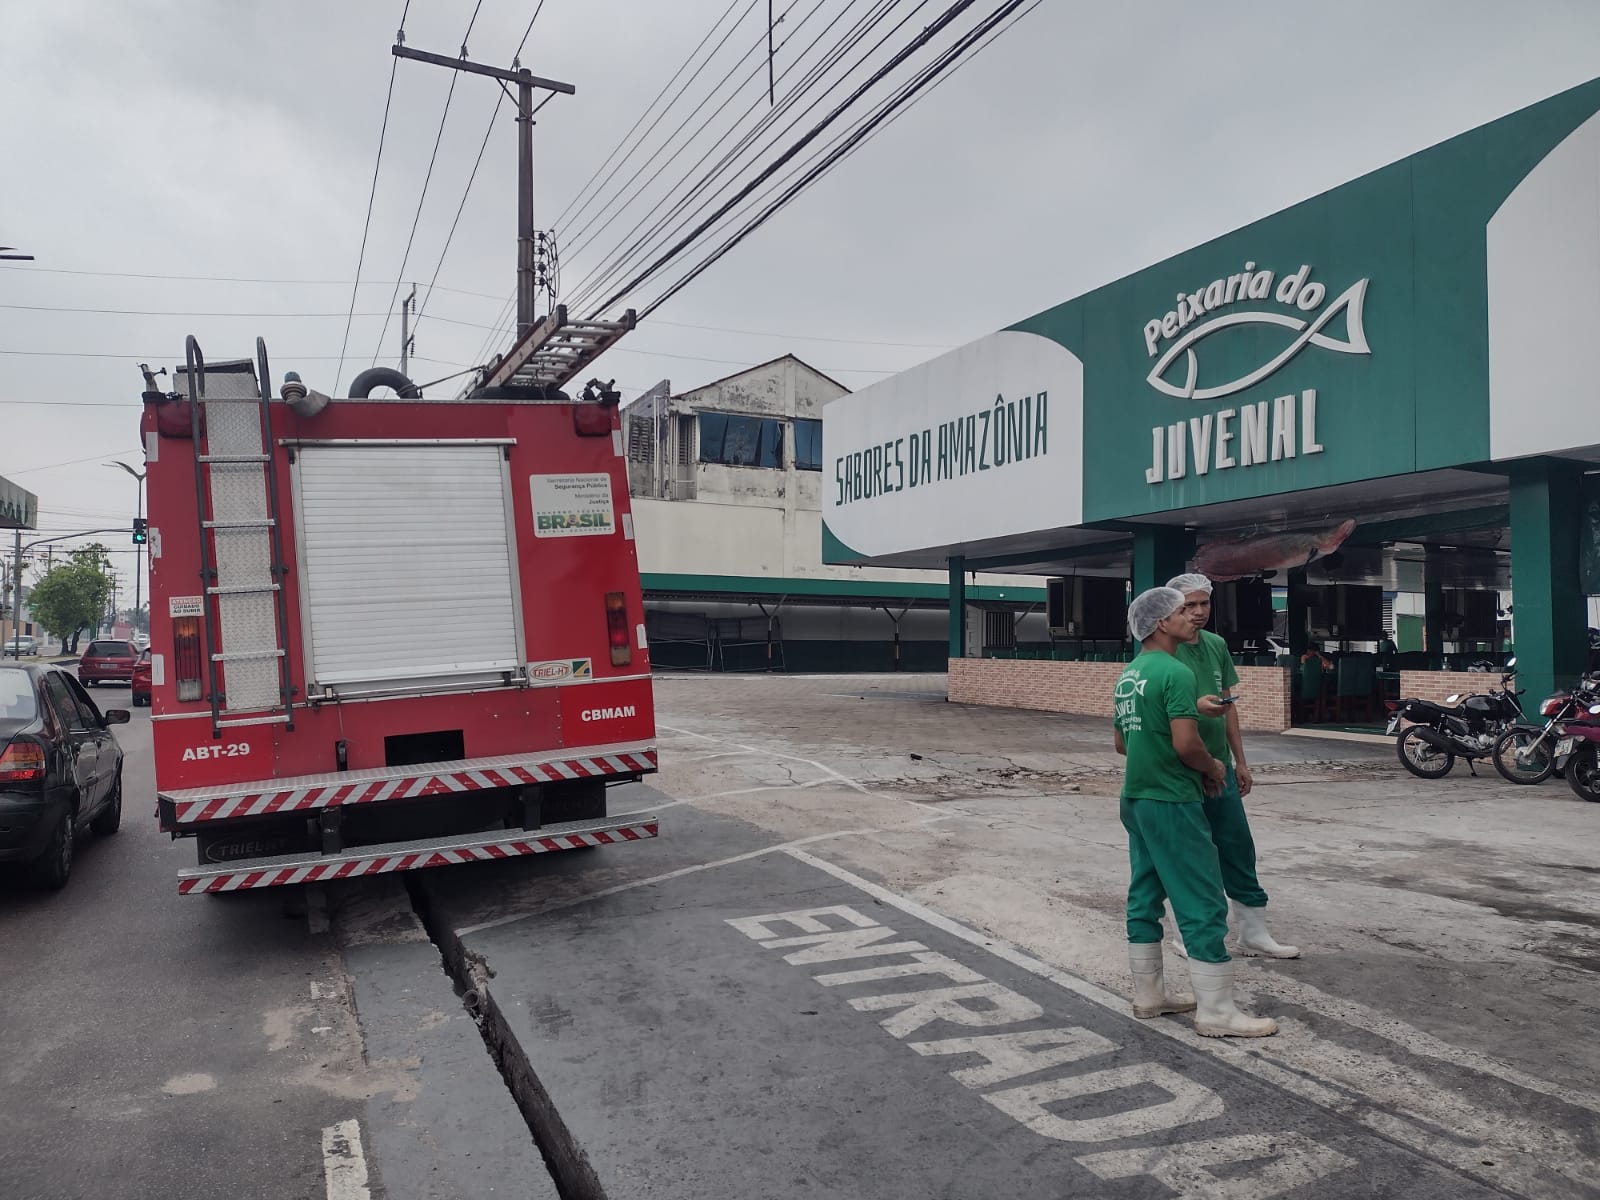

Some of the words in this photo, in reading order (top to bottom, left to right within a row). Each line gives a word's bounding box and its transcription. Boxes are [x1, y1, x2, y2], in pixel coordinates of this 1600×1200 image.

[1144, 261, 1275, 357] Peixaria
[1276, 264, 1326, 311] do
[835, 438, 903, 506] SABORES
[909, 429, 931, 488] DA
[937, 391, 1048, 482] AMAZÔNIA
[1145, 388, 1324, 484] JUVENAL
[537, 512, 611, 530] BRASIL
[533, 666, 569, 677] TRIEL-HT
[581, 705, 636, 722] CBMAM
[182, 742, 250, 761] ABT-29
[723, 904, 1359, 1200] ENTRADA
